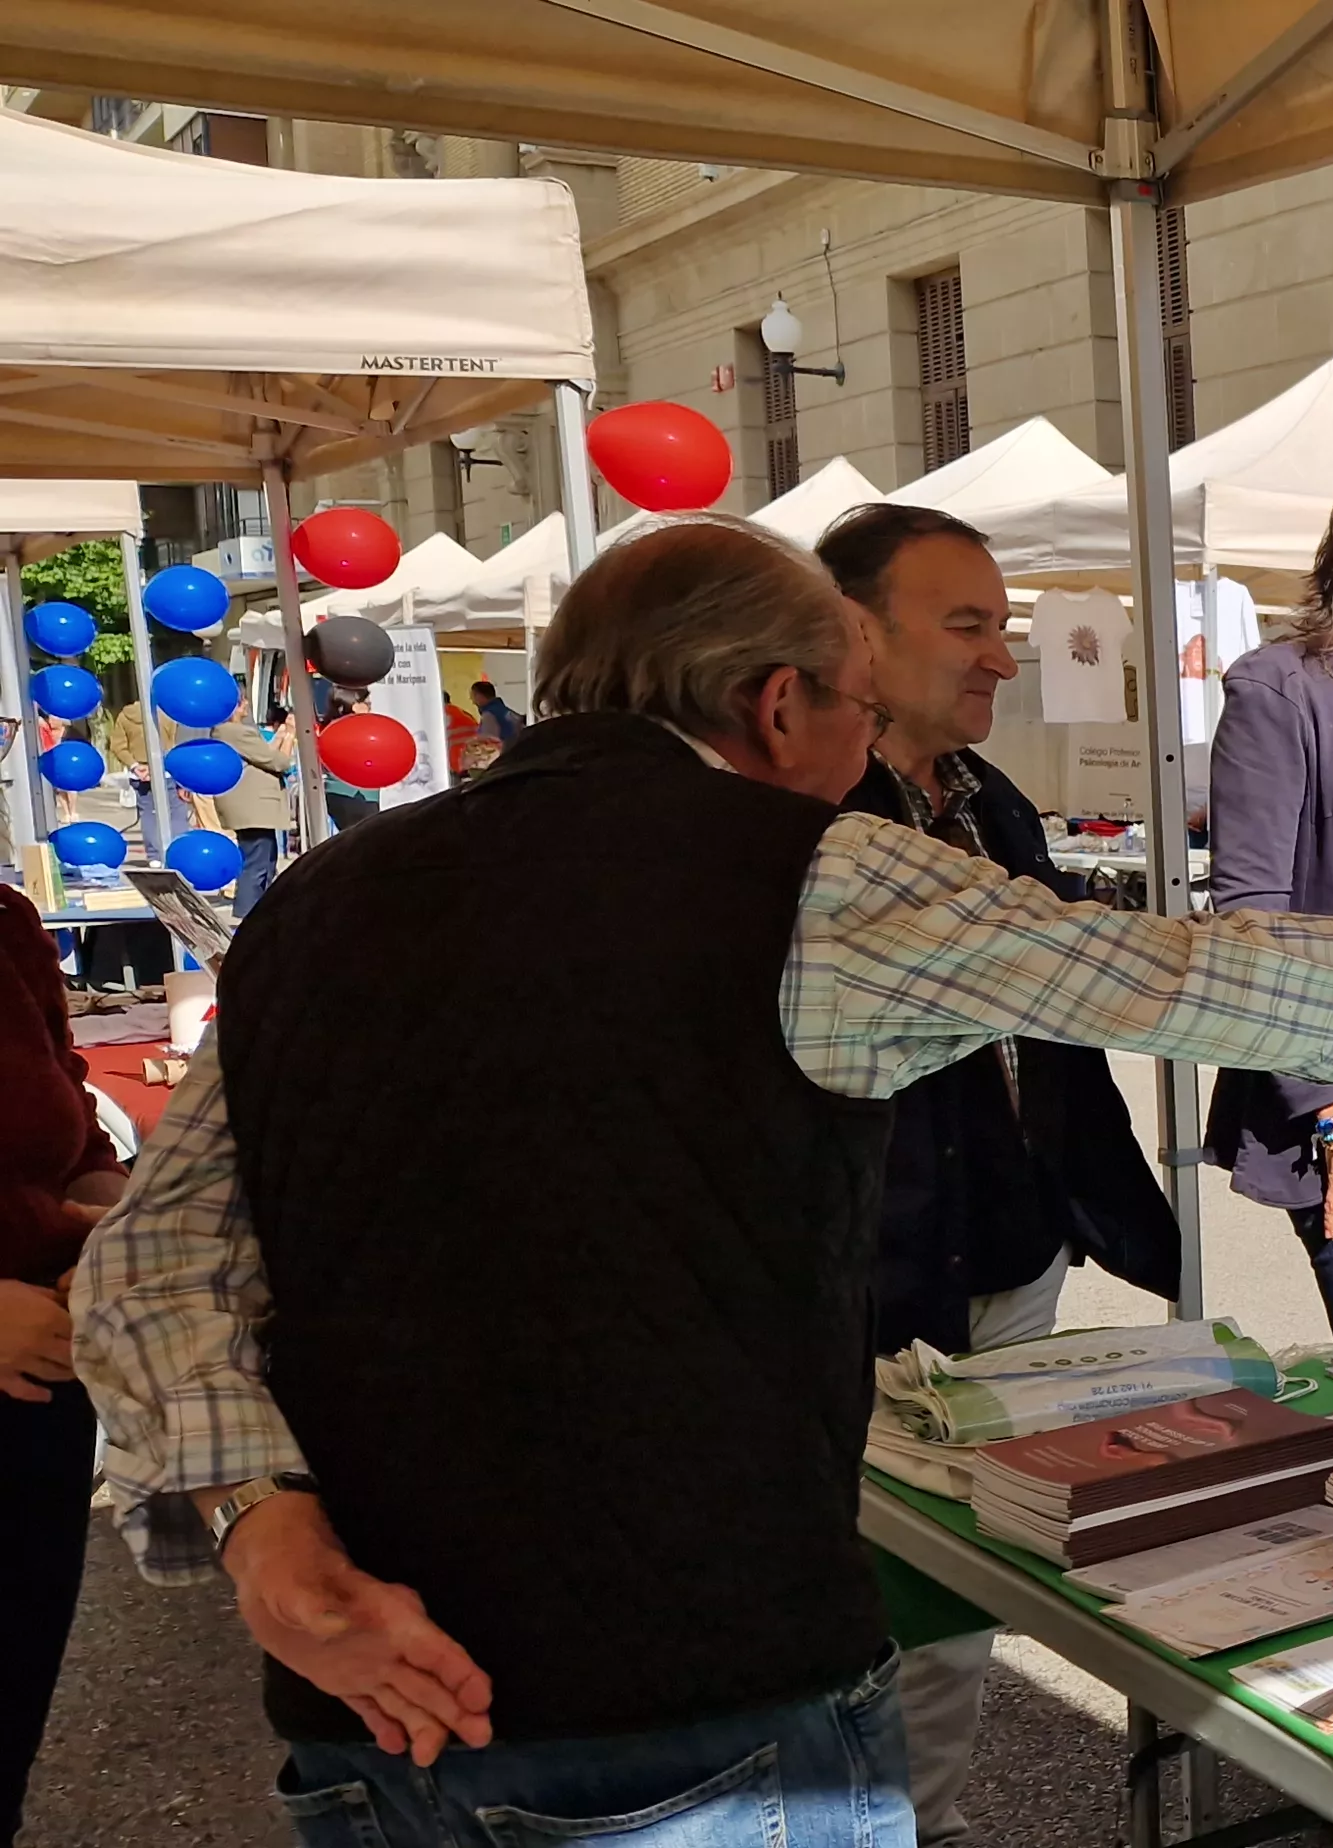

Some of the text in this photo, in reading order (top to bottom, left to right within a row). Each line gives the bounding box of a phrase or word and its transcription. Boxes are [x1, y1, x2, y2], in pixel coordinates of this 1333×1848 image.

[361, 355, 497, 371] MASTERTENT
[1080, 747, 1108, 756] Colegio
[1106, 1386, 1119, 1395] 37
